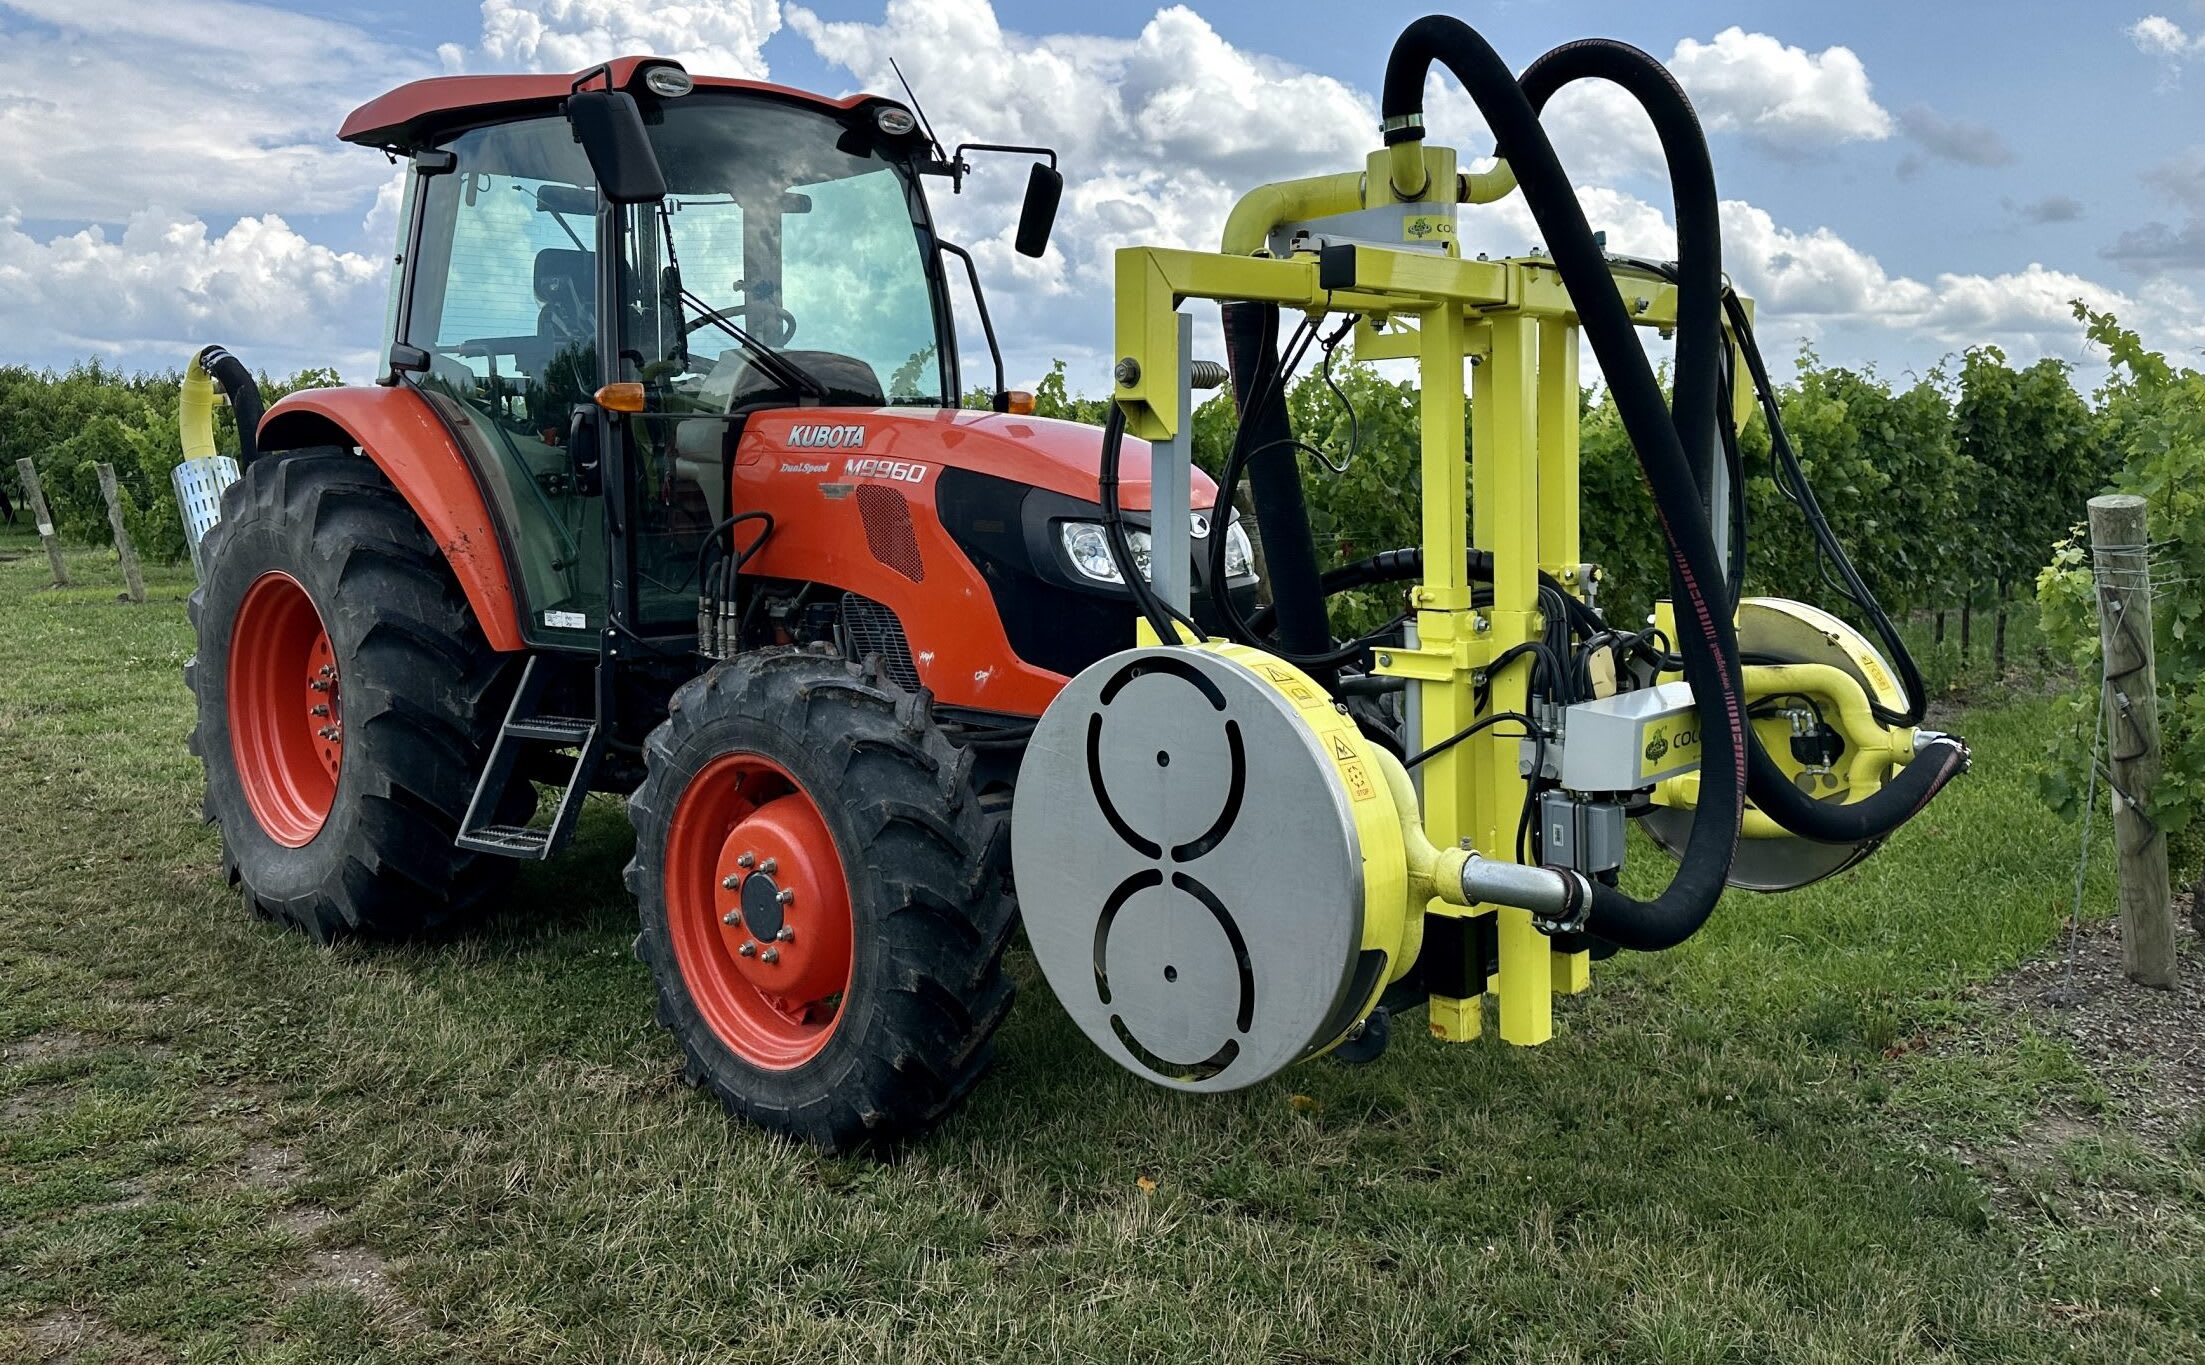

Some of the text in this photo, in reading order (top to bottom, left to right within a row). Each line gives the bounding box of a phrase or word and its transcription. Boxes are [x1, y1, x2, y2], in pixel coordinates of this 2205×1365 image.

[787, 424, 865, 448] KUBOTA
[844, 459, 927, 483] M9960
[1356, 788, 1369, 797] STOP
